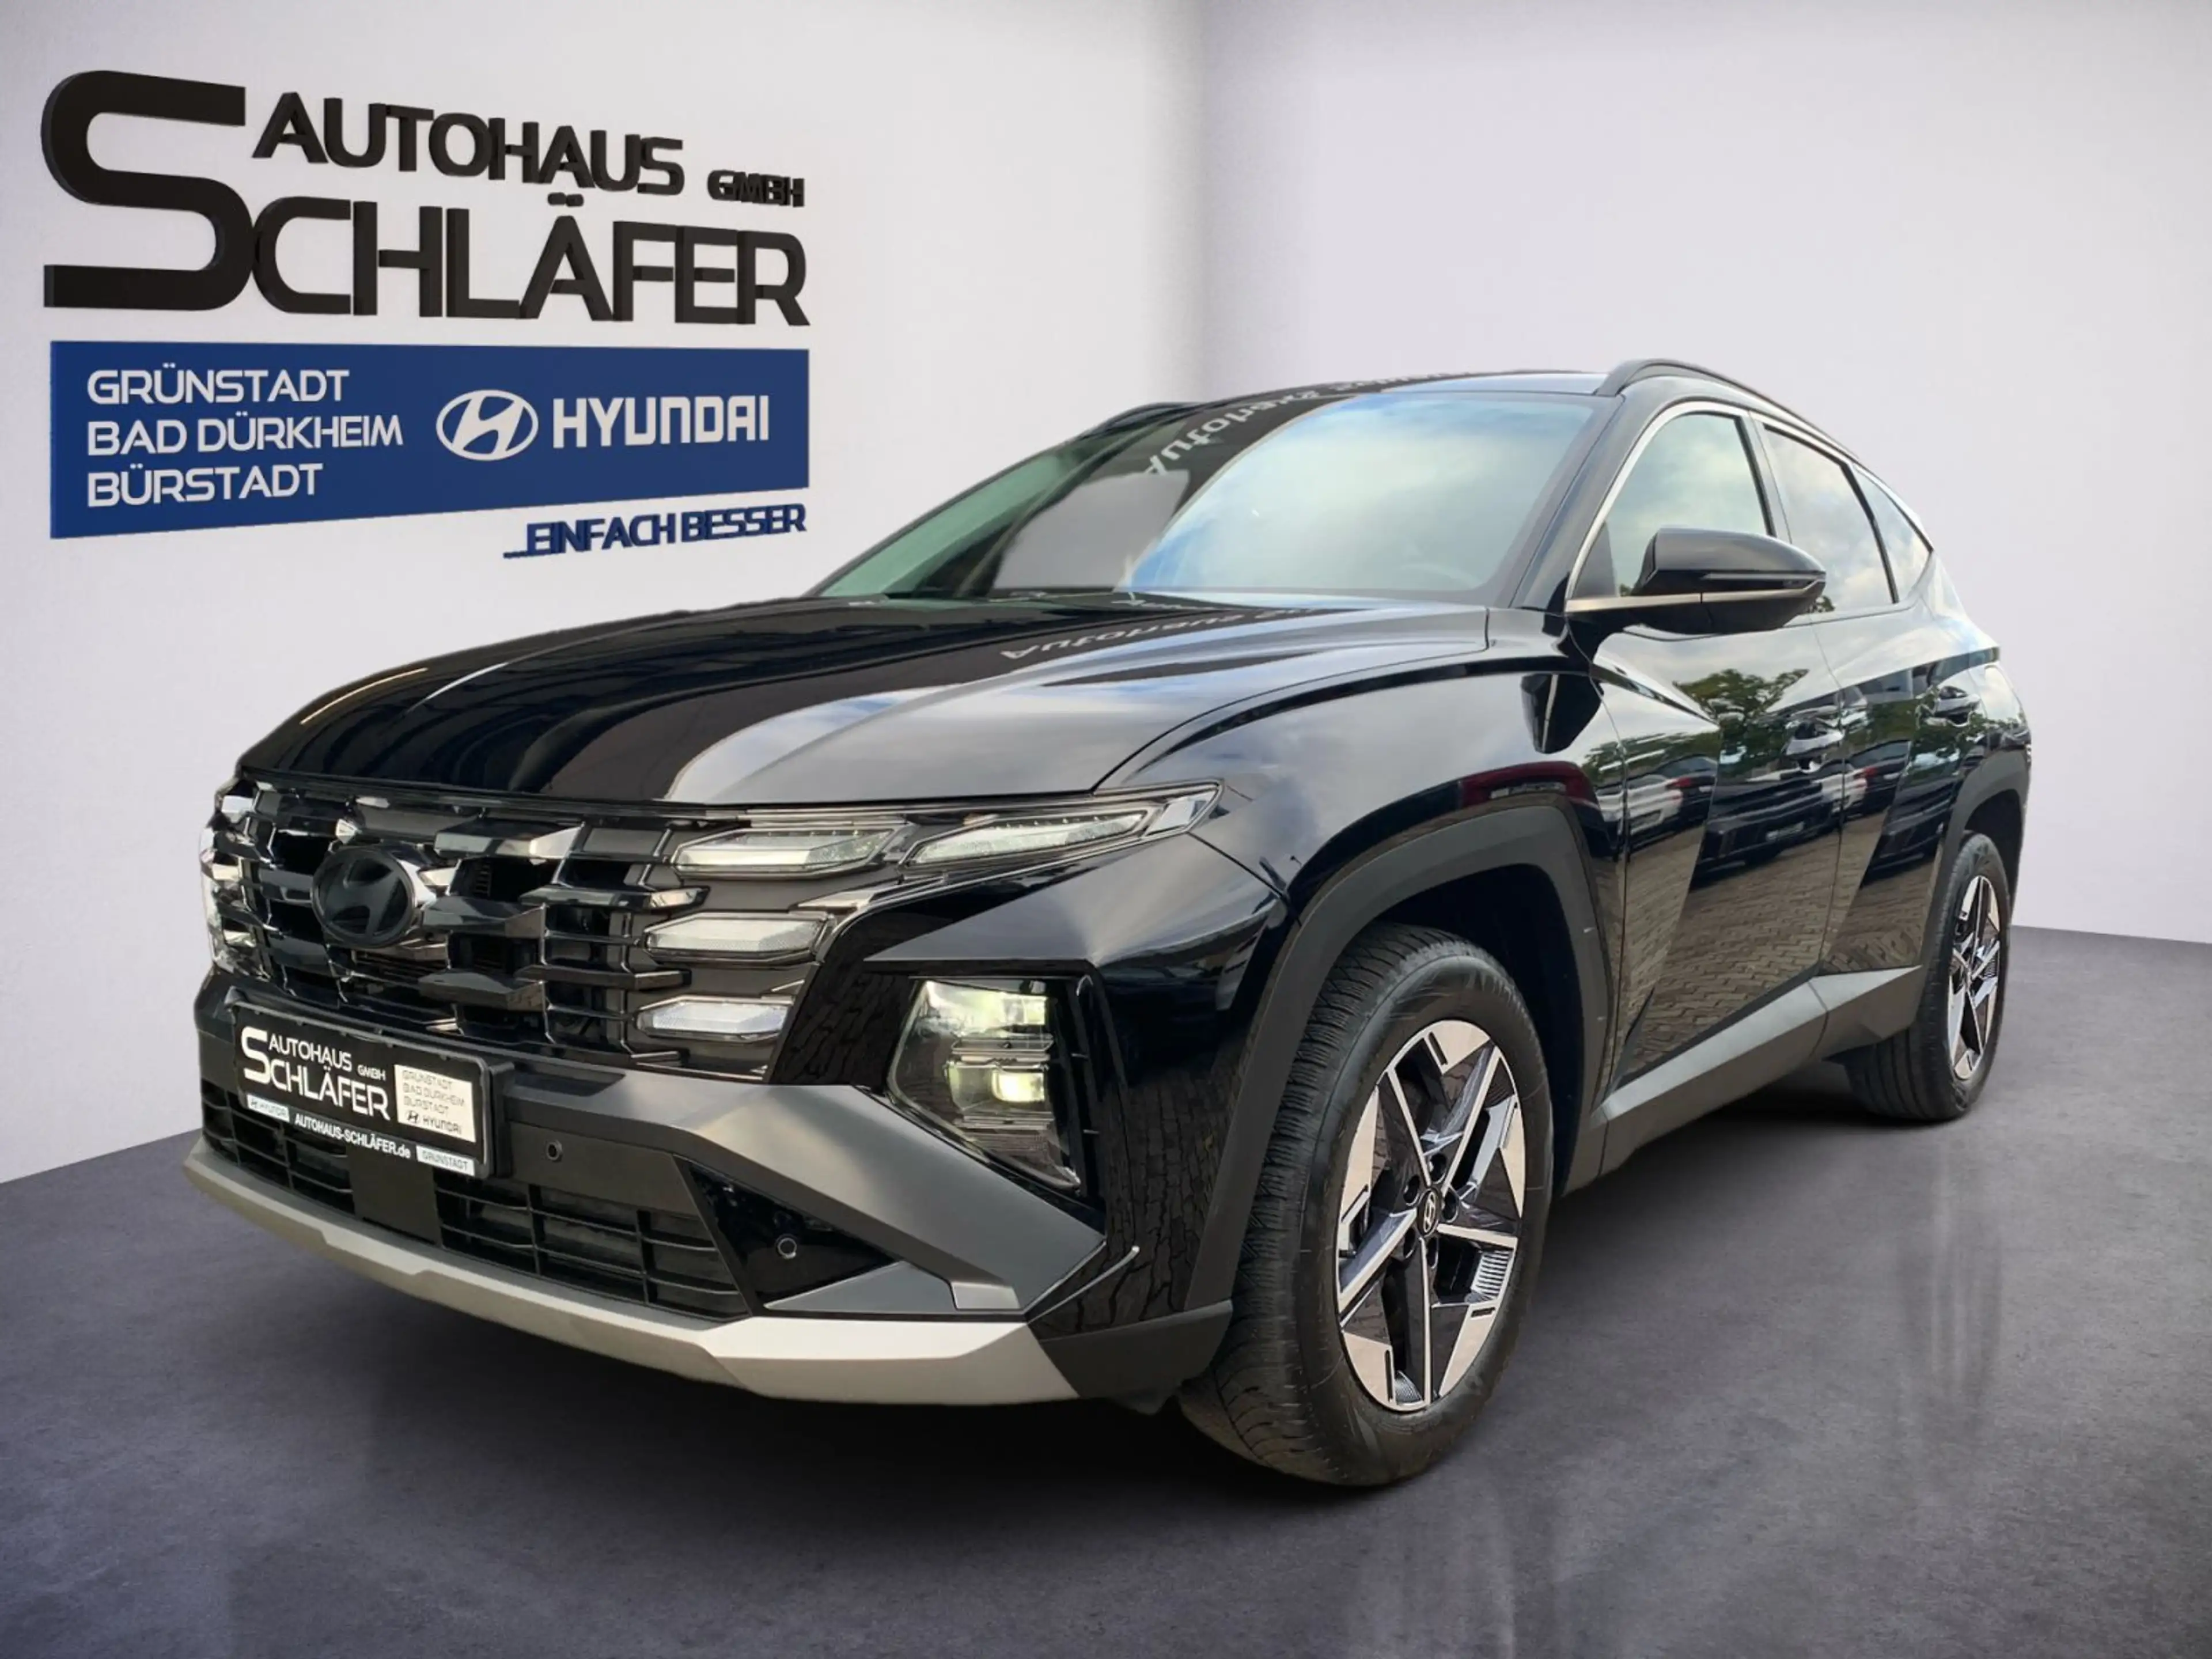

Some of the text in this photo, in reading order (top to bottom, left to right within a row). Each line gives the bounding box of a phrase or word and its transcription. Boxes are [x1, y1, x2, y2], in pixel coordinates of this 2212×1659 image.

[252, 92, 805, 208] AUTOHAUS GMBH
[40, 70, 810, 327] SCHLÄFER
[88, 363, 350, 404] GRÜNSTADT
[88, 411, 403, 456] BAD DÜRKHEIM
[553, 395, 770, 449] HYUNDAI
[88, 463, 323, 507] BÜRSTADT
[681, 503, 806, 543] BESSER
[241, 1026, 391, 1120] SCHLÄFER
[268, 1034, 353, 1072] AUTOHAUS
[295, 1113, 411, 1159] AUTOHAUS-SCHLÄFER.de
